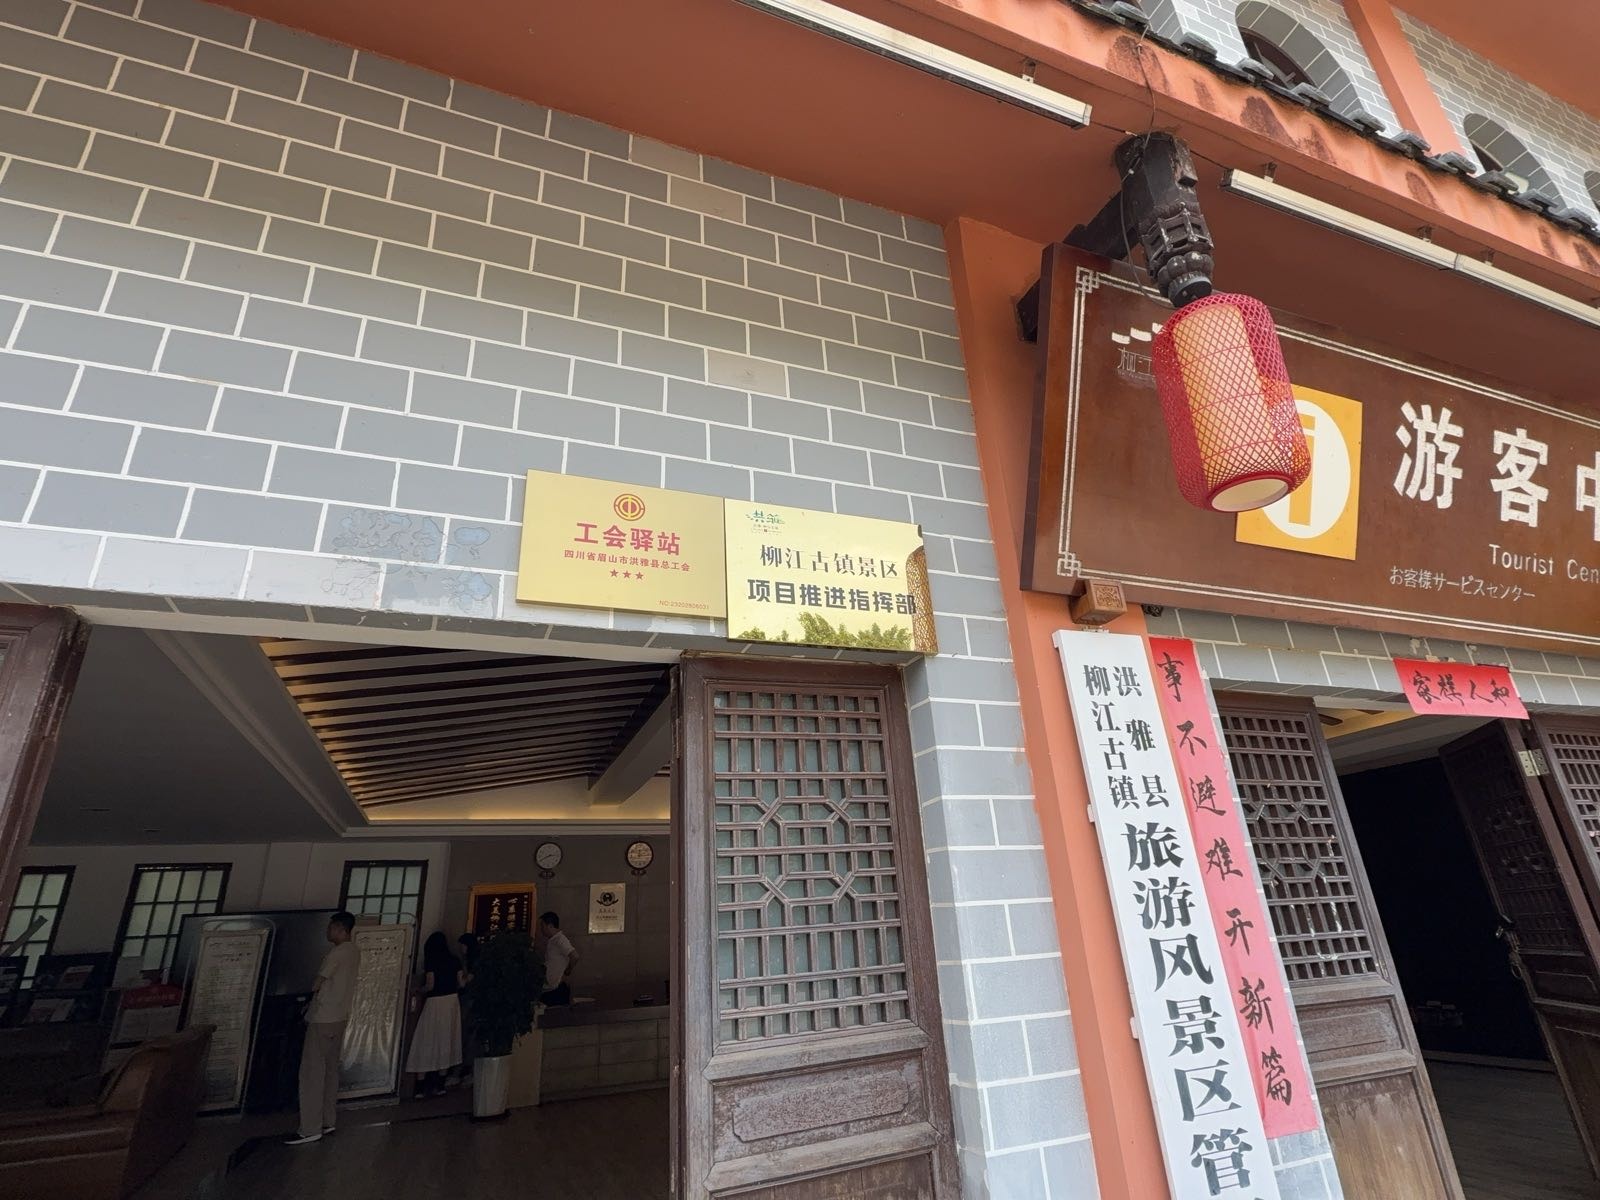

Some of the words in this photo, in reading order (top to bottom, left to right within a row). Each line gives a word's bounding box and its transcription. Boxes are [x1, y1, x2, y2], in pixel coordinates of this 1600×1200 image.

[1393, 401, 1600, 542] 游客中
[573, 522, 681, 556] 工会驿站
[564, 549, 690, 572] 四川省眉山市洪雅县总工会
[759, 544, 901, 579] 柳江古镇景区
[1488, 543, 1554, 576] Tourist
[1567, 558, 1600, 584] Cen
[747, 579, 918, 616] 项目推进指挥部
[1083, 664, 1141, 810] 柳江古镇
[1112, 665, 1170, 808] 洪雅县
[1120, 822, 1264, 1200] 旅游风景区管
